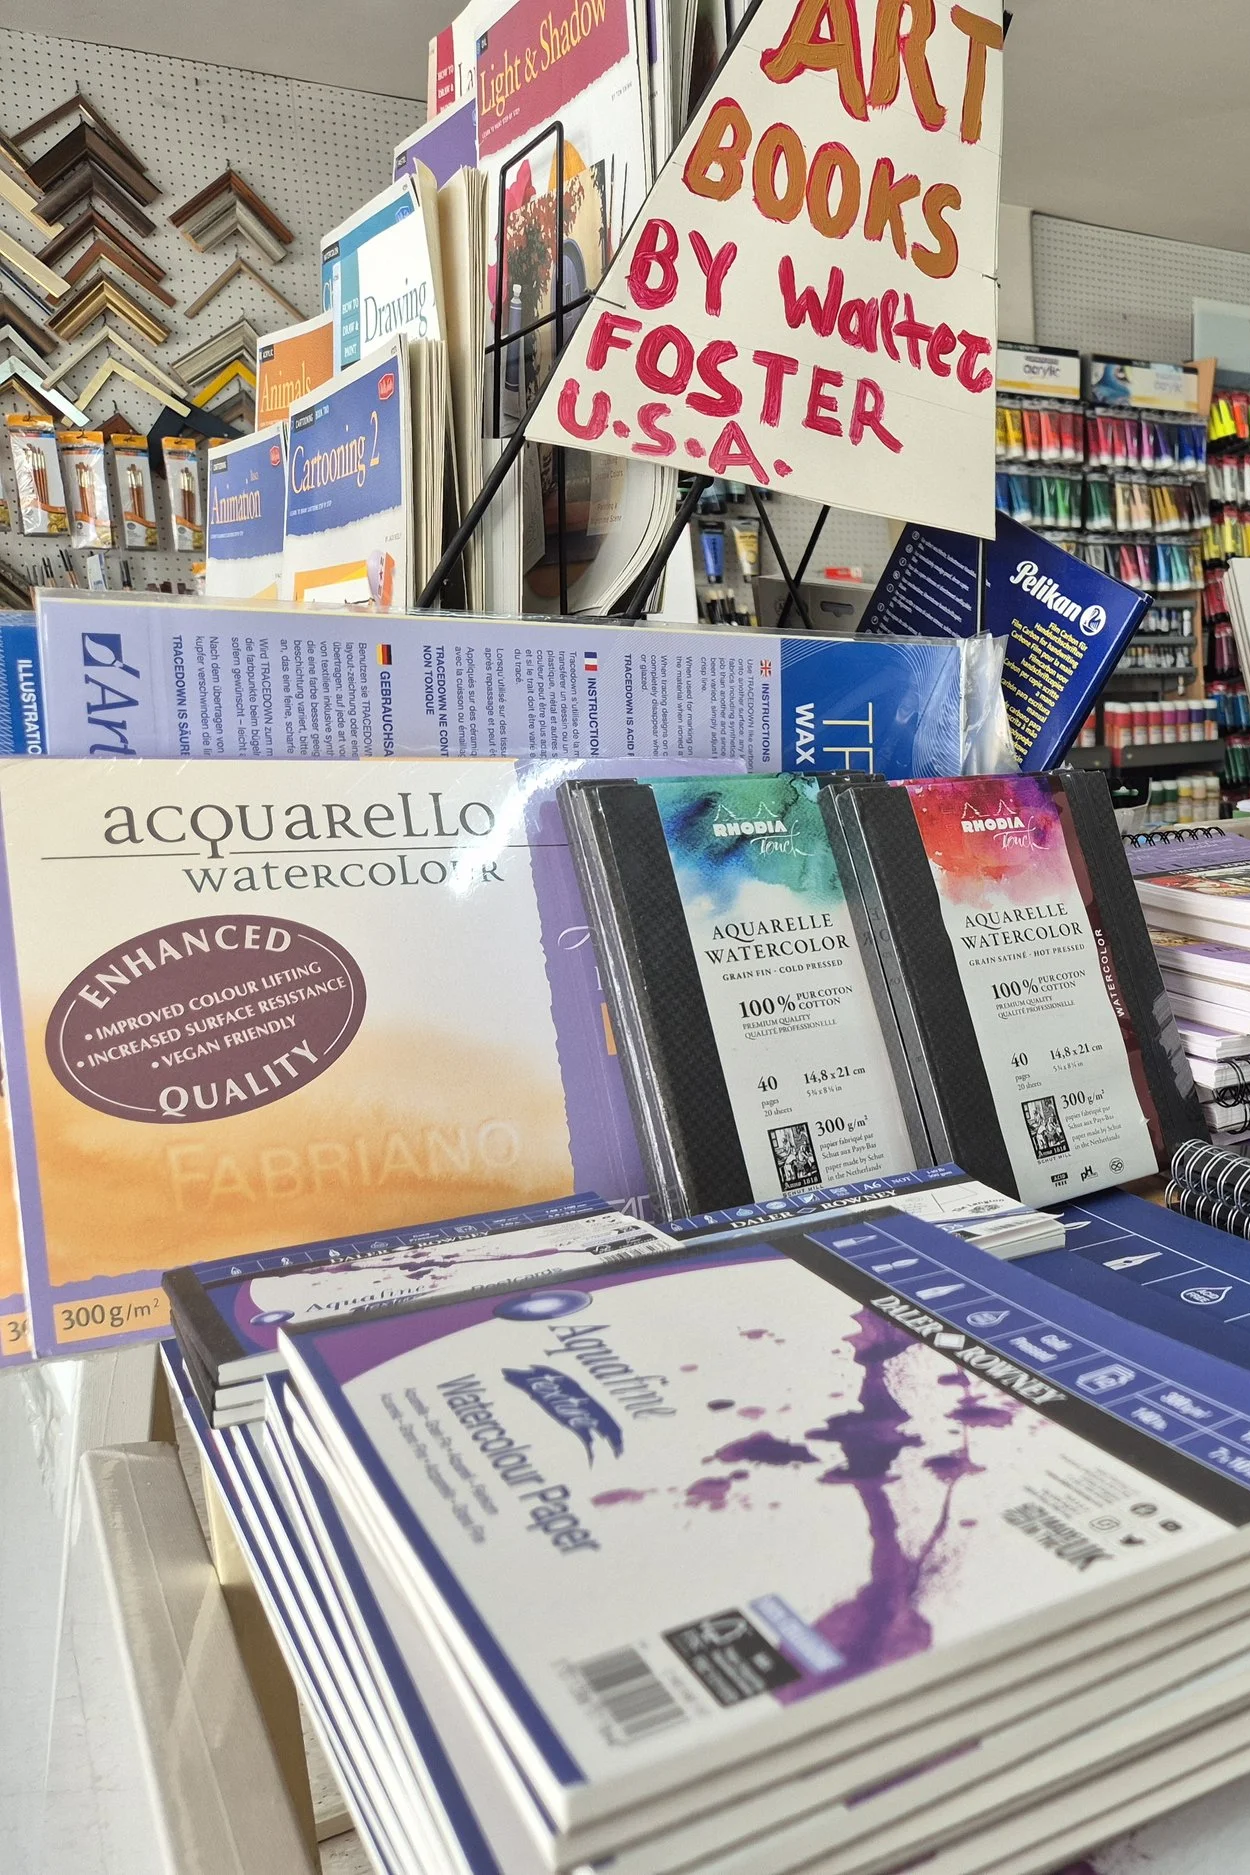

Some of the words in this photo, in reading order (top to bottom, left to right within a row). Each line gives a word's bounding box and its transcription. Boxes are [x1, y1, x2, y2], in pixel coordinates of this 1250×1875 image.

[480, 49, 522, 117] Light
[524, 48, 538, 82] &
[539, 0, 606, 72] Shadow
[760, 0, 1003, 145] ART
[682, 98, 962, 279] BOOKS
[364, 277, 427, 344] Drawing
[628, 218, 737, 317] BY
[778, 255, 993, 394] Walter
[260, 362, 311, 413] Animals
[585, 311, 904, 453] FOSTER
[292, 424, 366, 494] Cartooning
[370, 411, 380, 467] 2
[556, 378, 794, 485] U.S.A.
[211, 479, 262, 525] Animation
[1009, 560, 1083, 622] Pelikan
[172, 635, 186, 706] TRACEDOWN
[423, 645, 432, 669] NON
[436, 645, 447, 711] TRACEDOWN
[624, 654, 633, 714] TRACEDOWN
[17, 659, 43, 755] ILLUSTRATIO
[84, 673, 140, 755] Art
[177, 708, 188, 720] IS
[380, 671, 394, 757] GEBRAUCHSA
[424, 671, 435, 715] TOXIQUE
[439, 713, 448, 727] NE
[588, 678, 600, 756] INSTRUCTION
[626, 716, 634, 726] IS
[762, 683, 770, 762] INSTRUCTIONS
[626, 728, 634, 750] ACID
[794, 702, 816, 765] WAX
[713, 820, 787, 838] RHODIA
[961, 816, 1025, 833] RHODIA
[182, 855, 506, 895] watercolor
[712, 912, 834, 943] AQUARELLE
[960, 922, 1084, 951] WATERCOLOR
[965, 902, 1069, 931] AQUARELLE
[78, 924, 293, 1011] ENHANCED
[704, 934, 851, 966] WATERCOLOR
[722, 971, 754, 982] GRAIN
[755, 968, 772, 977] FIN
[779, 964, 804, 974] COLD
[806, 959, 843, 970] PRESSED
[968, 957, 997, 967] GRAIN
[997, 951, 1027, 963] SATINÉ
[1033, 948, 1050, 958] HOT
[1052, 943, 1085, 954] PRESSED
[1094, 928, 1125, 1017] WATERCOLOR
[87, 1028, 181, 1069] INCREASED
[184, 1008, 257, 1037] SURFACE
[257, 976, 349, 1015] RESISTANCE
[95, 1003, 186, 1041] IMPROVED
[188, 979, 260, 1012] COLOUR
[260, 961, 323, 990] LIFTING
[739, 997, 775, 1019] 100
[778, 995, 796, 1013] %
[796, 991, 818, 1001] PUR
[818, 985, 853, 997] COTON
[798, 998, 841, 1010] COTTON
[161, 1039, 222, 1069] VEGAN
[222, 1014, 299, 1051] FRIENDLY
[158, 1038, 321, 1118] QUALITY
[757, 1076, 778, 1093] 40
[803, 1069, 829, 1085] 14,8
[836, 1066, 851, 1078] 21
[853, 1066, 866, 1075] cm
[815, 1117, 845, 1137] 300
[163, 1118, 524, 1212] FABRIANO
[863, 1181, 882, 1192] A6
[729, 1211, 795, 1229] DALER
[820, 1189, 897, 1210] ROWNEY
[544, 1324, 677, 1421] Aquafine
[870, 1294, 945, 1339] DALER
[955, 1341, 1069, 1407] ROWNEY
[435, 1372, 547, 1491] Watercolour
[518, 1482, 602, 1557] Paper
